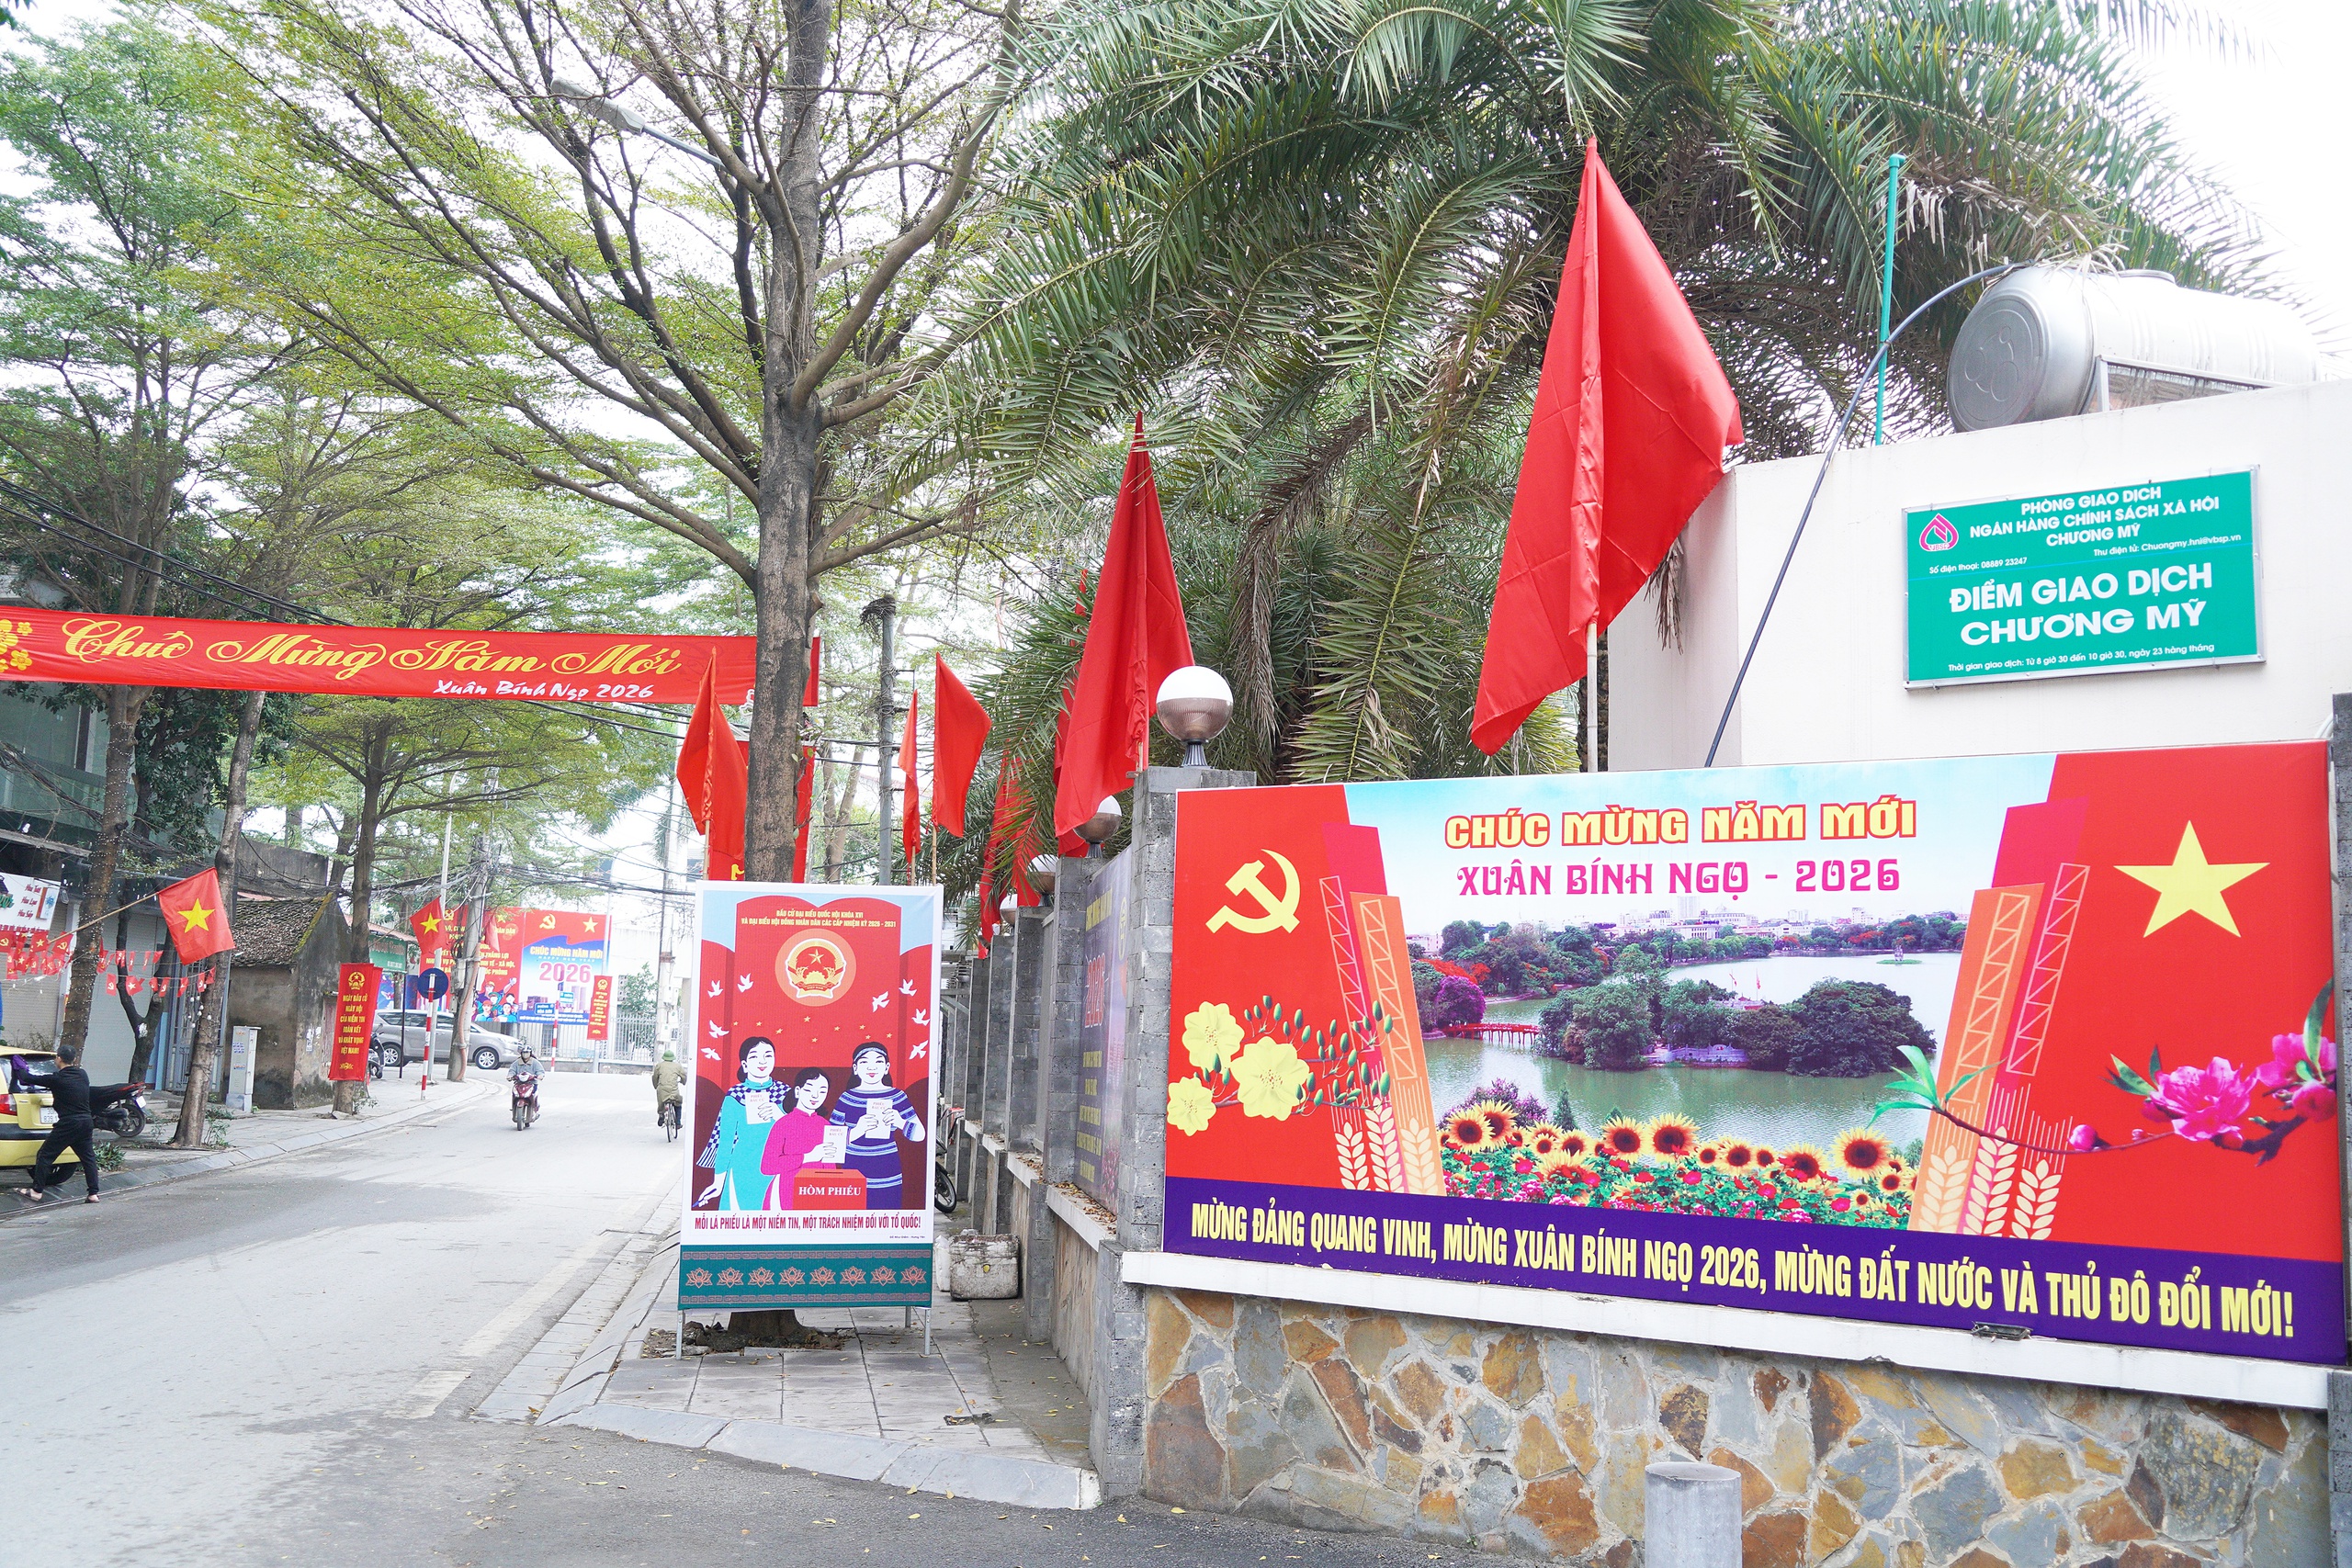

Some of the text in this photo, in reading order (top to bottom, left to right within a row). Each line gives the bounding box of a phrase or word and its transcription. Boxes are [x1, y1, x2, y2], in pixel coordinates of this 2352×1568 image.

[2021, 486, 2162, 515] PHÒNG GIAO DỊCH
[1970, 495, 2220, 538] NGÂN HÀNG CHÍNH SÁCH XÃ HỘI
[2046, 524, 2141, 547] CHƯƠNG MỸ
[2109, 547, 2127, 555] điện
[2129, 544, 2140, 552] tử:
[2141, 535, 2242, 551] Chuongmy.hni@vbsp.vn
[1929, 557, 2028, 574] Số điện thoại: 08889 23247
[1949, 562, 2212, 613] ĐIỂM GIAO DỊCH
[1961, 598, 2207, 646] CHƯƠNG MỸ
[62, 618, 684, 680] Chúc Mừng Năm Mới
[1949, 663, 1964, 671] Thời
[1965, 663, 1983, 671] gian
[1984, 661, 2003, 671] giao
[2004, 660, 2024, 669] dịch:
[2026, 657, 2035, 666] Từ
[2043, 655, 2057, 666] giờ
[2070, 652, 2086, 662] đến
[2099, 650, 2113, 661] giờ
[2114, 650, 2127, 659] 30,
[2129, 649, 2151, 659] ngày
[2152, 647, 2163, 656] 23
[2165, 646, 2188, 655] hàng
[2188, 644, 2215, 653] tháng
[433, 679, 655, 702] Xuân Bính Ngọ 2026
[1444, 794, 1917, 849] CHÚC MỪNG NĂM MỚI
[1456, 859, 1553, 896] XUÂN
[1565, 857, 1653, 896] BÍNH
[1668, 861, 1750, 901] NGỌ
[1794, 858, 1901, 893] 2026
[530, 945, 549, 955] CHÚC
[539, 962, 592, 983] 2026
[798, 1184, 862, 1196] HÒM PHIẾU
[695, 1212, 922, 1232] MỖI LÁ PHIẾU LÀ MỘT NIỀM TIN, MỘT TRÁCH NHIỆM ĐỐI VỚI TỔ QUỐC!
[1191, 1196, 2295, 1338] MỪNG ĐẢNG QUANG VINH, MỪNG XUÂN BÍNH NGỌ 2026, MỪNG ĐẤT NƯỚC VÀ THỦ ĐÔ ĐỔI MỚI!
